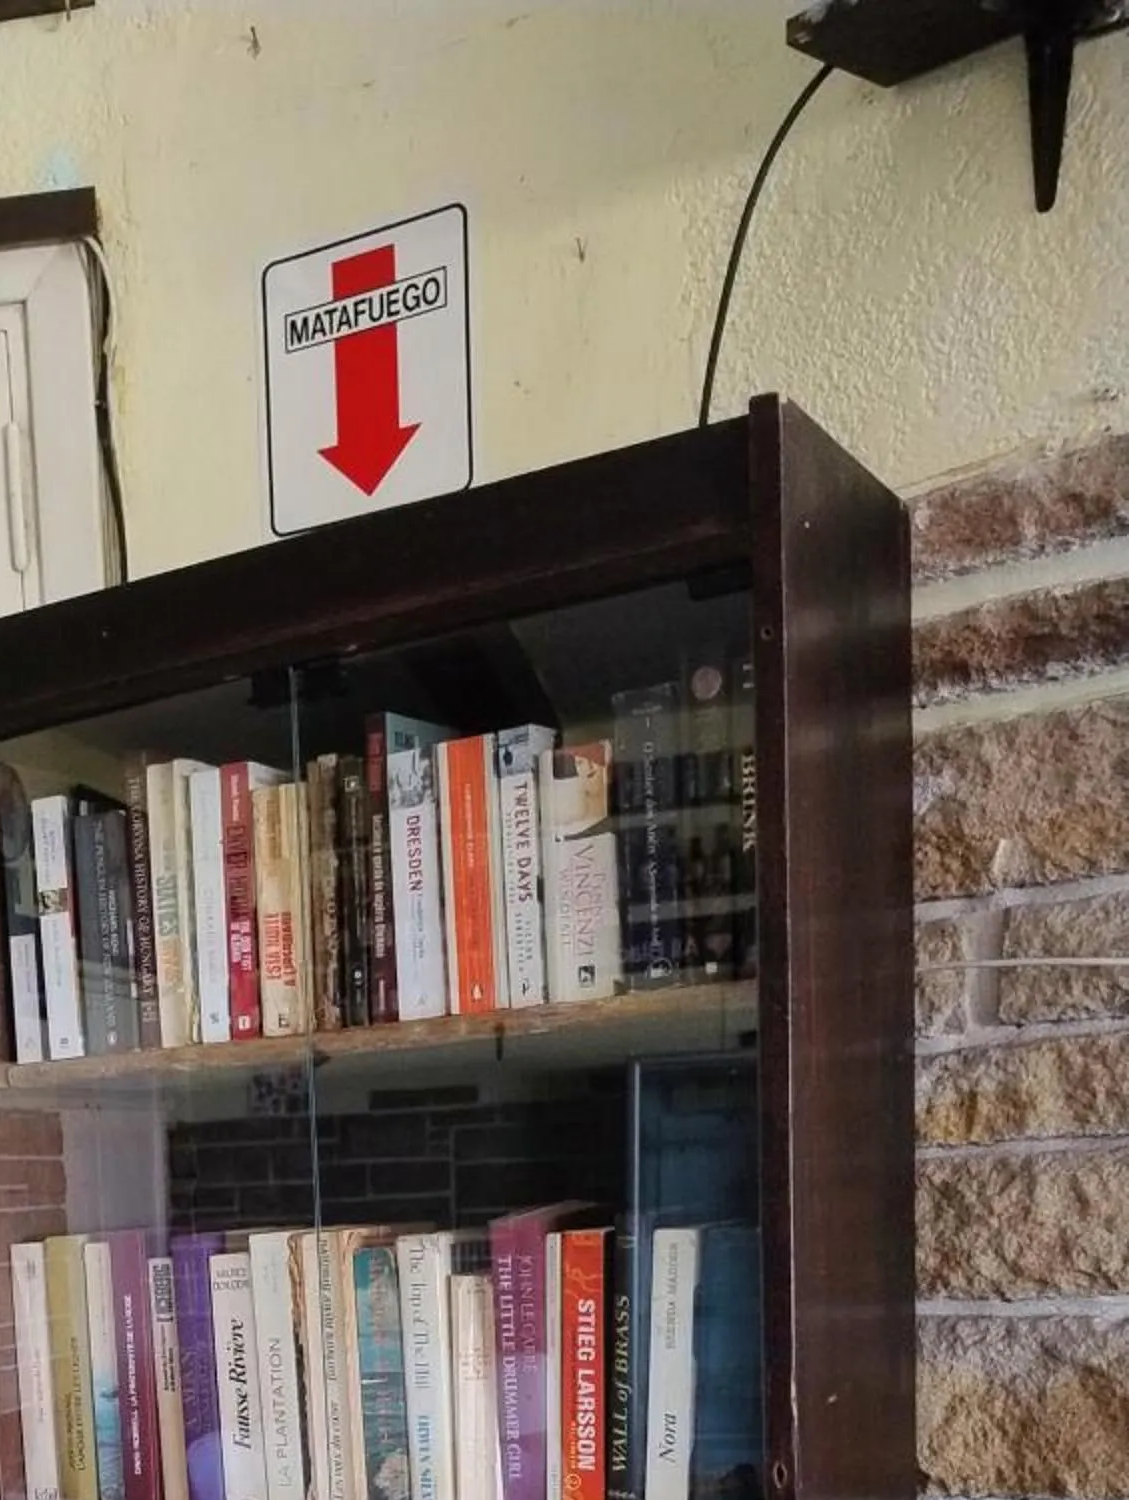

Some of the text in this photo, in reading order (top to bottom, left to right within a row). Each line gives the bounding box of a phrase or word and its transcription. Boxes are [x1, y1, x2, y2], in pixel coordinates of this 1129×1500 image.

[290, 276, 441, 346] MATAFUEGO
[406, 814, 423, 894] DRESDEN
[513, 781, 534, 905] TWELVE DAYS
[574, 843, 596, 957] VINCENZI
[516, 1253, 535, 1299] JOHN
[496, 1254, 523, 1478] THE LITTLE DRUMMER GIRL
[613, 1294, 630, 1372] BRASS
[268, 1337, 289, 1459] PLANTATION
[576, 1297, 596, 1471] STIEG LARSSON
[613, 1381, 633, 1401] of
[611, 1409, 628, 1471] WALL
[656, 1409, 678, 1464] Nora
